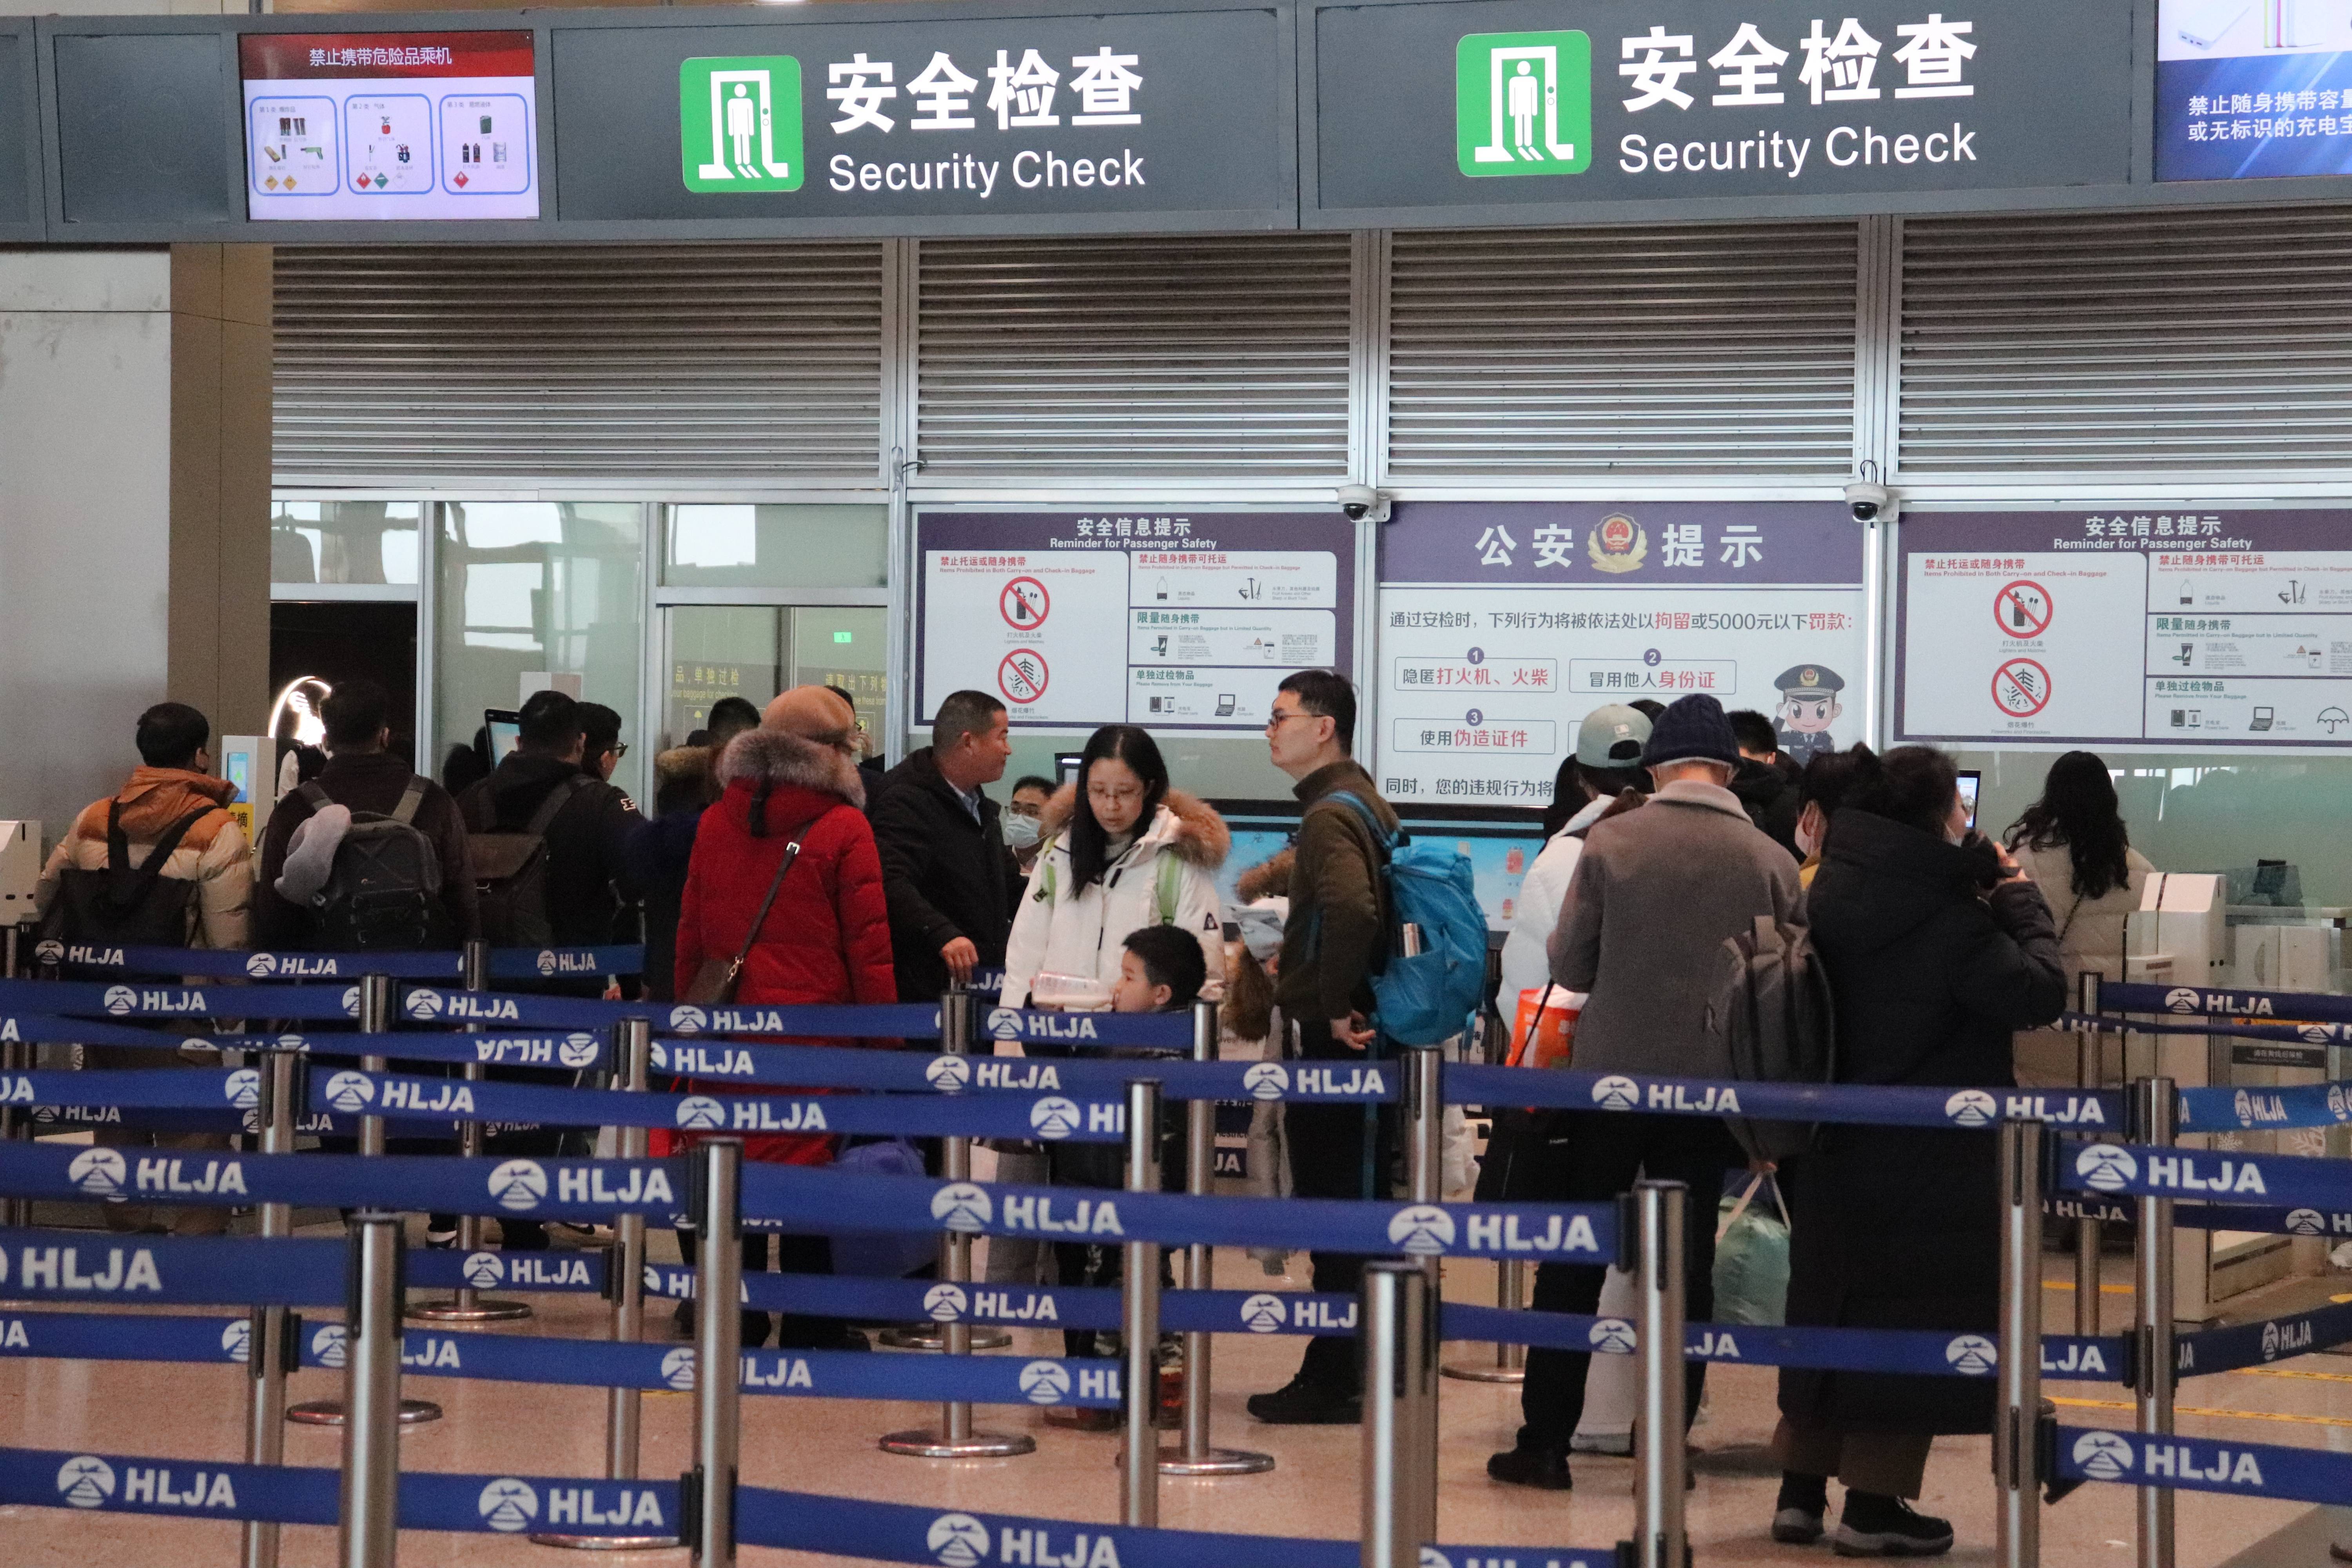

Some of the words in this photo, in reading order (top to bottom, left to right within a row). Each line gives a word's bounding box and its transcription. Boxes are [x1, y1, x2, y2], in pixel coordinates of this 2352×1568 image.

[309, 47, 452, 66] 禁止携带危险品乘机
[1619, 13, 1977, 113] 安全检查
[826, 46, 1143, 134] 安全检查
[1619, 129, 1811, 178] Security
[1826, 122, 1977, 167] Check
[829, 153, 999, 198] Security
[1013, 149, 1145, 189] Check
[1076, 517, 1191, 537] 安全信息提示
[2085, 516, 2221, 536] 安全信息提示
[1050, 538, 1101, 548] Reminder
[1104, 538, 1120, 548] for
[1123, 538, 1178, 550] Passenger
[1182, 538, 1217, 550] Safety
[1475, 524, 1573, 568] 公安
[1662, 524, 1763, 568] 提示
[2054, 538, 2115, 549] Reminder
[2118, 538, 2136, 549] for
[2140, 538, 2206, 550] Passenger
[2210, 538, 2252, 550] Safety
[940, 556, 1026, 566] 禁止托运或随身携带
[1139, 554, 1227, 563] 禁止随身携带可托运
[1925, 559, 2025, 569] 禁止托运或随身携带
[2160, 555, 2264, 565] 禁止随身携带可托运
[1138, 612, 1200, 623] 限量随身携带
[2157, 618, 2230, 630] 限量随身携带
[1136, 670, 1194, 680] 单独过检物品
[1403, 668, 1548, 686] 隐匿打火机、火柴
[1590, 671, 1715, 689] 冒用他人身份证
[2155, 681, 2224, 691] 单独过检物品
[1421, 729, 1528, 748] 使用伪造证件
[1386, 778, 1553, 797] 同时，您的违规行为将
[69, 946, 125, 965] HLJA
[281, 958, 337, 975] HLJA
[559, 953, 596, 971] HLJA
[143, 991, 206, 1011] HLJA
[448, 996, 519, 1019] HLJA
[2206, 994, 2273, 1015] HLJA
[713, 1011, 783, 1032] HLJA
[1028, 1016, 1097, 1039] HLJA
[675, 1048, 755, 1075] HLJA
[976, 1063, 1060, 1091] HLJA
[1298, 1069, 1385, 1094] HLJA
[381, 1081, 474, 1113] HLJA
[1648, 1084, 1741, 1113] HLJA
[2252, 1096, 2288, 1120] HLJA
[65, 1105, 121, 1123] HLJA
[733, 1102, 827, 1131] HLJA
[2006, 1097, 2105, 1124] HLJA
[137, 1158, 249, 1195] HLJA
[559, 1168, 673, 1203] HLJA
[2148, 1156, 2267, 1194] HLJA
[1003, 1196, 1124, 1236] HLJA
[2056, 1200, 2127, 1222] HLJA
[1467, 1214, 1599, 1251] HLJA
[22, 1248, 162, 1291] HLJA
[511, 1259, 590, 1285] HLJA
[974, 1292, 1058, 1321] HLJA
[1294, 1301, 1357, 1328] HLJ
[2280, 1319, 2312, 1351] HLJA
[2145, 1444, 2264, 1486] HLJA
[125, 1467, 236, 1508] HLJA
[549, 1488, 664, 1527] HLJA
[1000, 1528, 1120, 1568] HLJA
